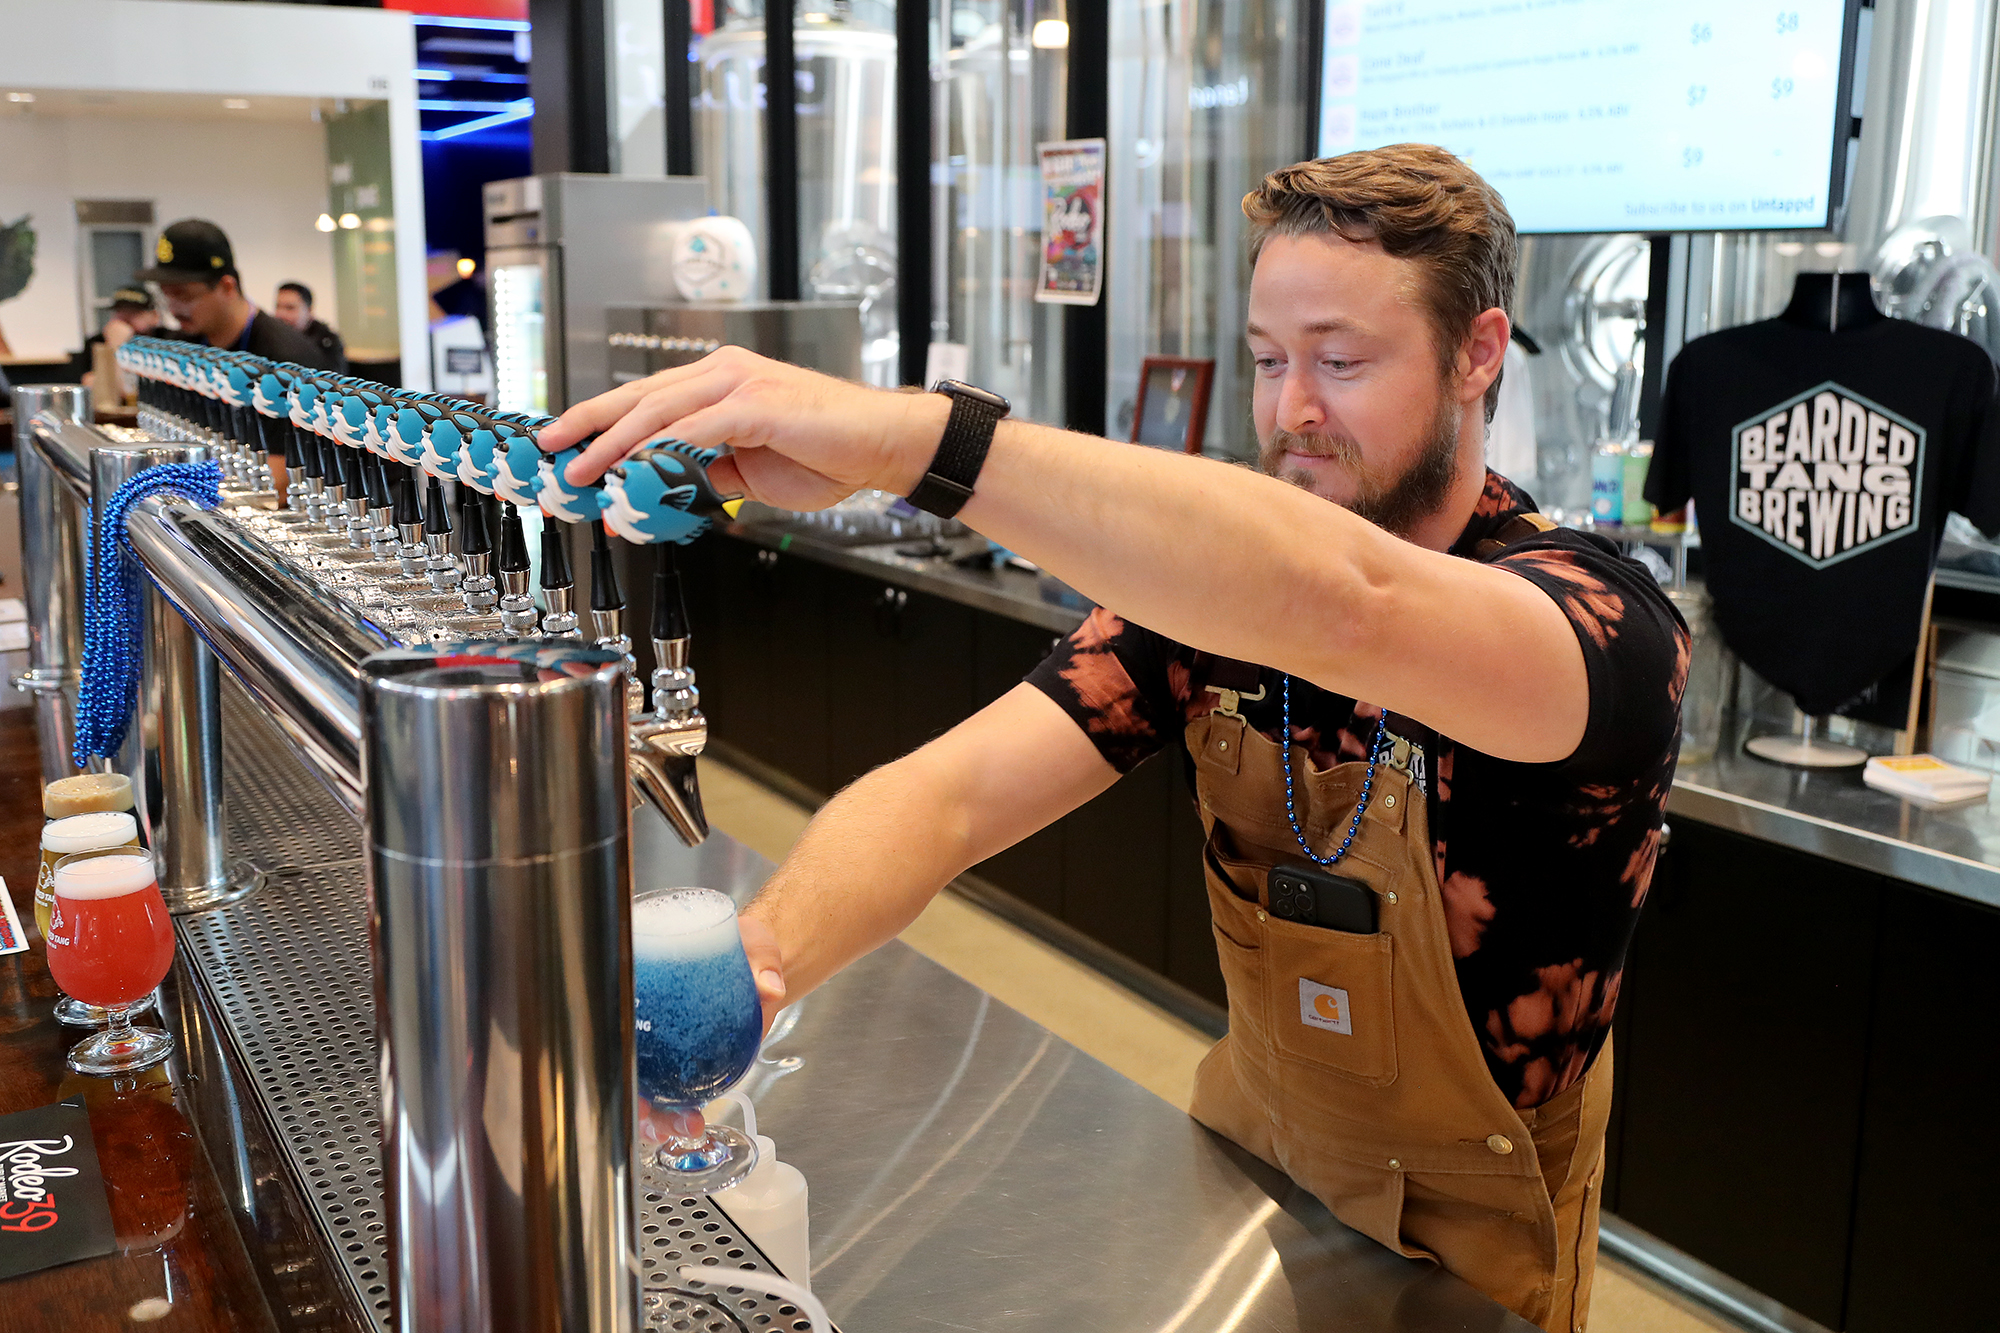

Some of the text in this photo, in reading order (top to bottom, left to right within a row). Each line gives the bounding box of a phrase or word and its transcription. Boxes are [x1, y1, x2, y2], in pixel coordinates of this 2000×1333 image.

[1690, 21, 1712, 46] $6
[1776, 10, 1800, 36] $8
[1686, 83, 1708, 108] $7
[1771, 76, 1795, 101] $9
[1683, 146, 1705, 169] $9
[1624, 193, 1815, 216] Subscribe to us on Untappd
[1740, 391, 1916, 466] BEARDED
[1740, 462, 1911, 497] TANG
[1738, 487, 1911, 560] BREWING
[0, 1134, 80, 1202] Rodeo
[0, 1193, 59, 1232] 39
